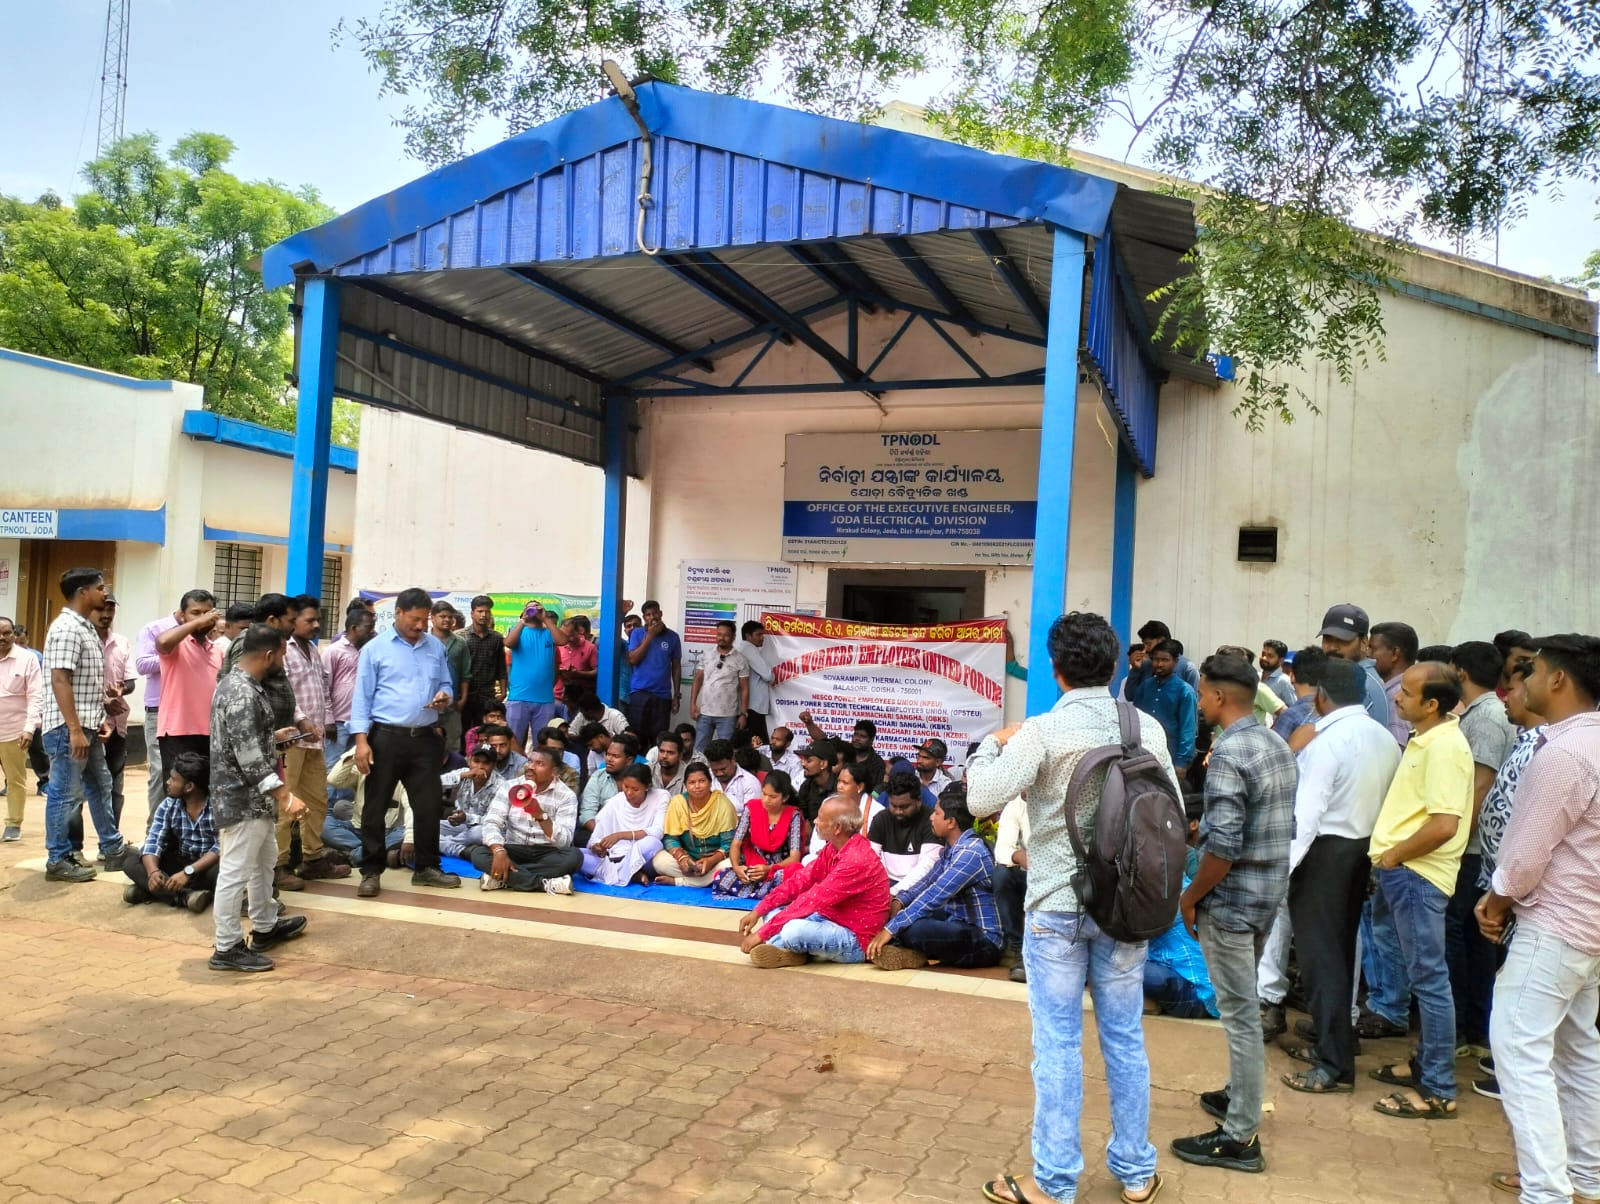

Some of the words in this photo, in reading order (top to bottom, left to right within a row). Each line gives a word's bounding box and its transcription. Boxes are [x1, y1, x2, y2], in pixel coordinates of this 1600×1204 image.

[881, 434, 941, 446] TPNODL
[819, 465, 865, 485] ନିର୍ବାହୀ
[807, 504, 845, 513] OFFICE
[847, 504, 862, 513] OF
[864, 504, 885, 513] THE
[888, 504, 949, 513] EXECUTIVE
[952, 504, 1014, 514] ENGINEER,
[3, 512, 52, 523] CANTEEN
[831, 516, 860, 525] JODA
[863, 516, 929, 525] ELECTRICAL
[934, 516, 987, 525] DIVISION
[0, 526, 30, 535] TPNODL,
[33, 527, 53, 535] JODA
[801, 645, 854, 674] WORKERS
[859, 644, 921, 669] EMPLOYEES
[922, 650, 962, 682] UNITED
[871, 676, 903, 684] THERMAL
[823, 701, 847, 709] SECTOR
[951, 710, 982, 718] (OPSTEU)
[853, 711, 893, 719] KARMACHARI
[930, 723, 952, 731] (KBKS)
[875, 735, 918, 743] KARMACHARI
